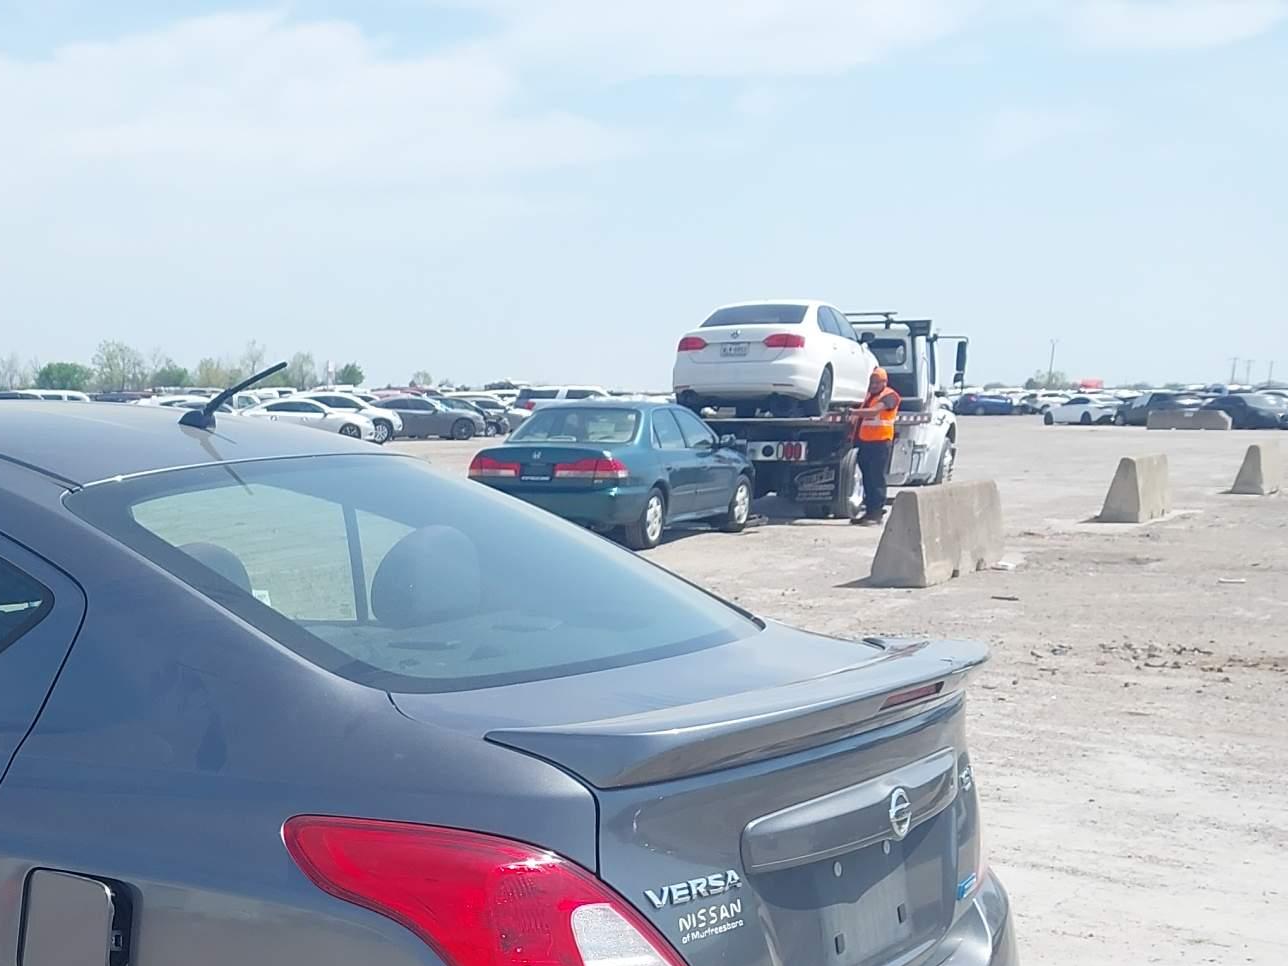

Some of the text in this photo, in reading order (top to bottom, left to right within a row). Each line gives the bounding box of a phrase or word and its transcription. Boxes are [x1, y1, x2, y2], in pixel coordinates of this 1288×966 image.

[643, 869, 743, 909] VERSA
[678, 899, 743, 932] NISSAN
[681, 934, 691, 944] of
